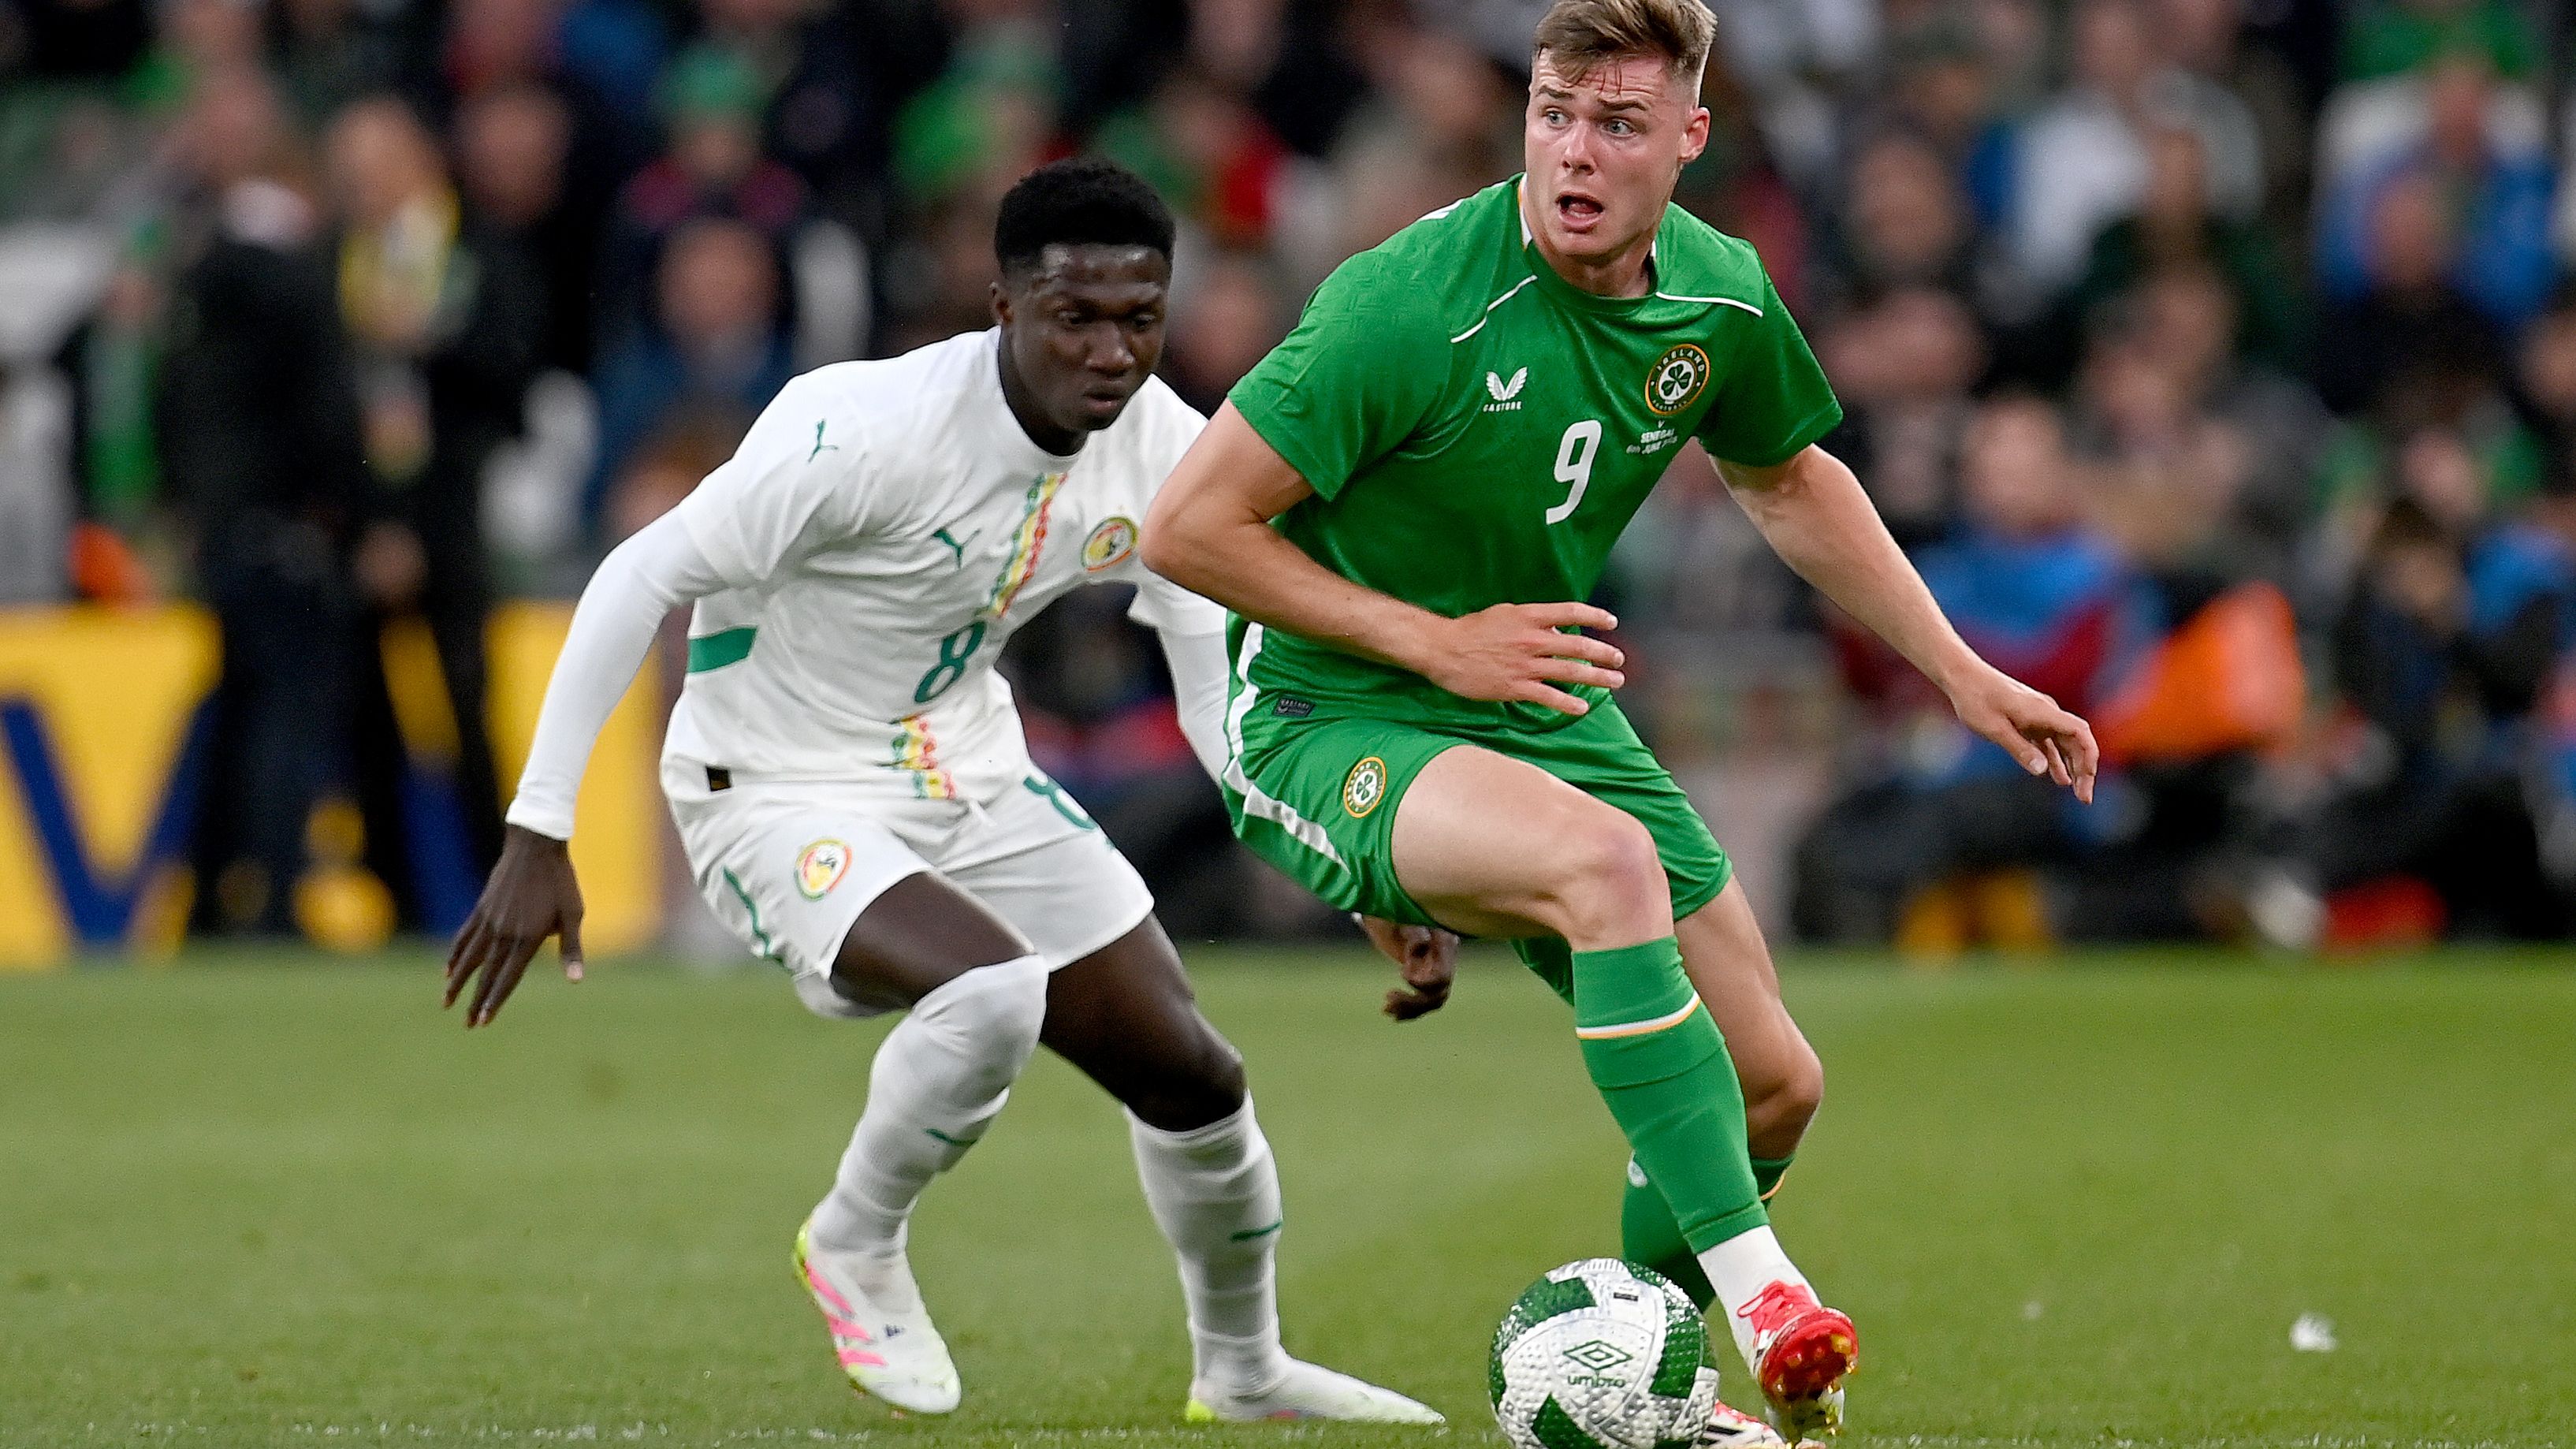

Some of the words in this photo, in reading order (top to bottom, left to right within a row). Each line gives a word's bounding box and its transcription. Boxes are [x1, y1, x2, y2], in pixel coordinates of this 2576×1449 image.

[1483, 401, 1522, 412] CASTORE
[1546, 419, 1603, 526] 9
[914, 620, 988, 703] 8
[1567, 1369, 1626, 1388] umbro
